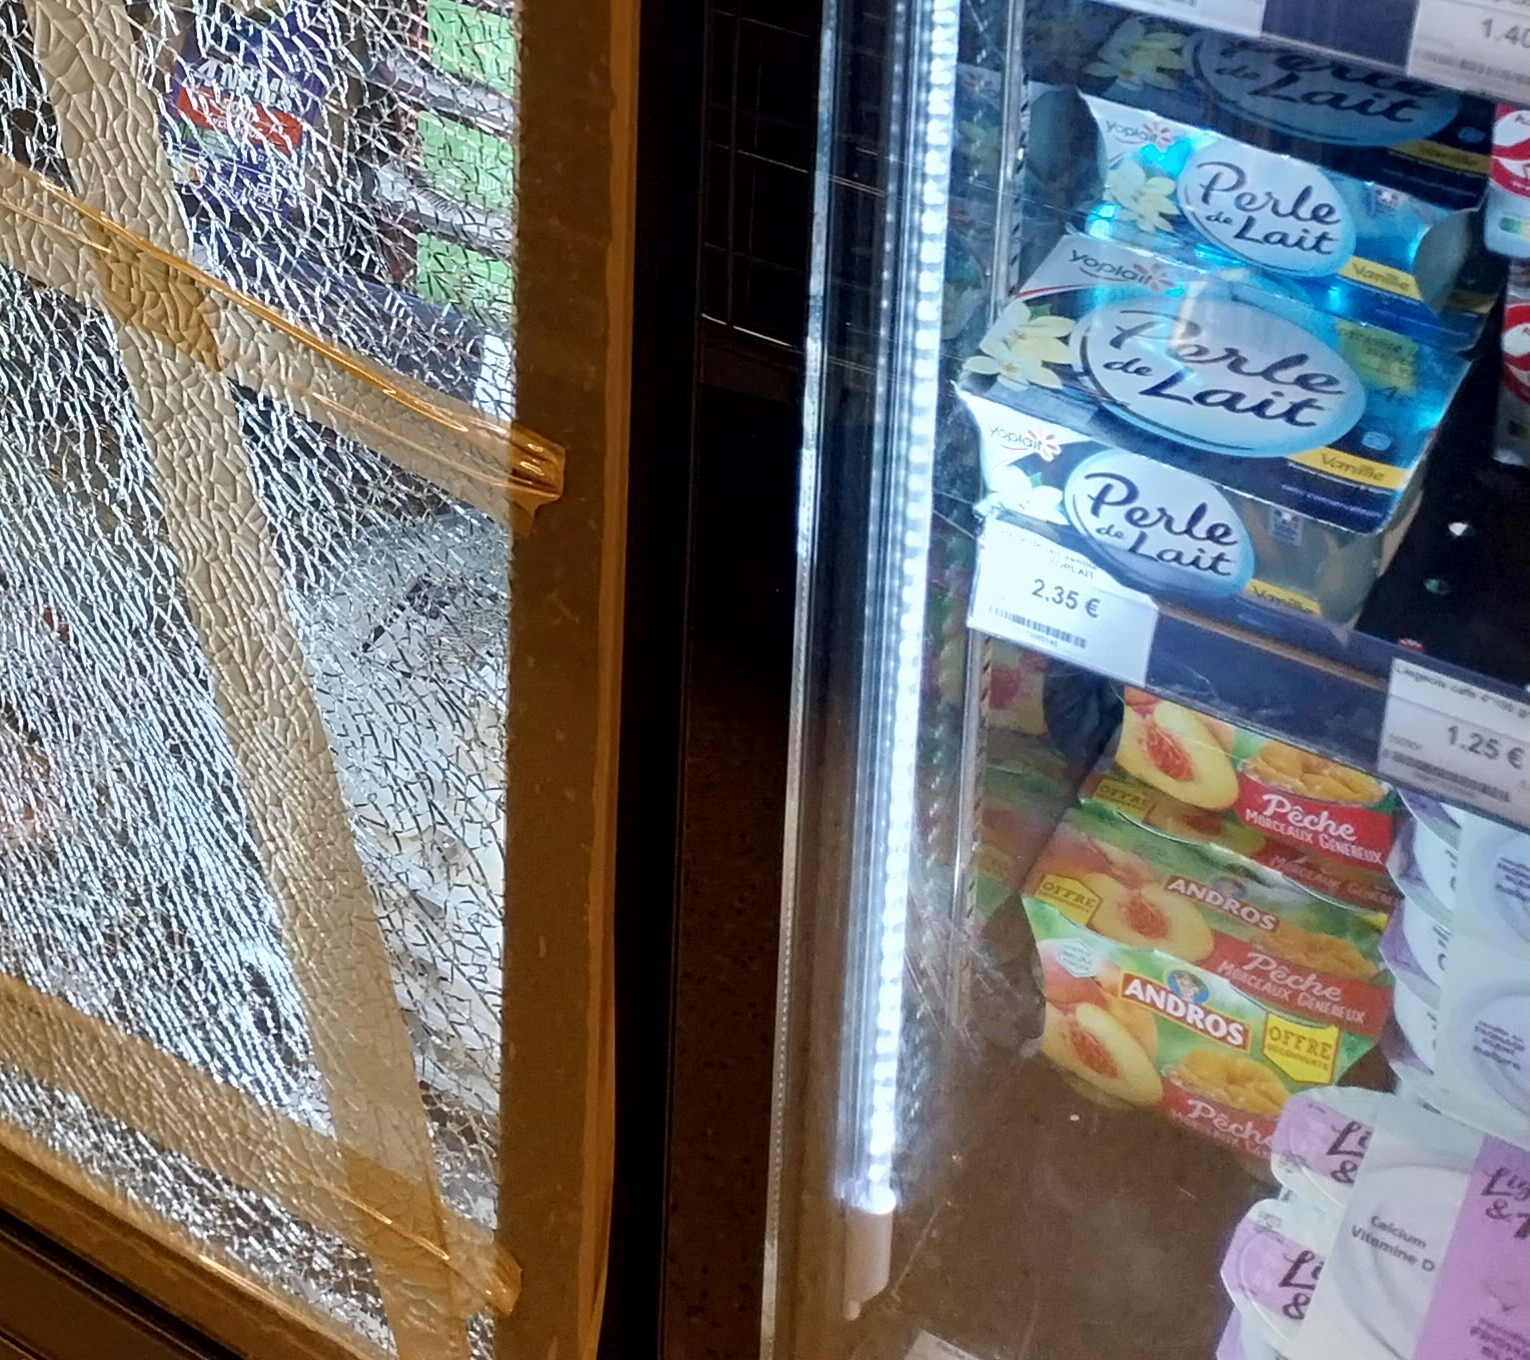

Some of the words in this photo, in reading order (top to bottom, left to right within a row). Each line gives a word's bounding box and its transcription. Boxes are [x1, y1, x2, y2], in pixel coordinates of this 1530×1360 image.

[1248, 70, 1423, 124] Lait
[1104, 119, 1158, 144] yoplait
[1196, 160, 1343, 226] Perle
[1205, 211, 1233, 226] de
[1234, 214, 1339, 256] Lait
[1070, 249, 1152, 286] yoplait
[1351, 260, 1411, 293] Vanille
[1108, 308, 1346, 396] Perle
[1102, 356, 1155, 378] de
[1137, 372, 1328, 429] Lait
[988, 425, 1046, 450] yoplait
[1319, 452, 1387, 483] Vanille
[1084, 470, 1241, 547] Perle
[1095, 521, 1125, 540] de
[1128, 531, 1236, 579] Lait
[1031, 578, 1080, 611] 2.35
[1084, 597, 1102, 619] €
[1447, 725, 1501, 761] 1.25
[1507, 746, 1526, 770] €
[1261, 792, 1359, 843] Pêche
[1041, 880, 1097, 910] OFFRE
[1166, 877, 1280, 932] ANDROS
[1242, 949, 1343, 1003] Pêche
[1123, 978, 1246, 1049] ANDROS
[1269, 1025, 1333, 1060] OFFRE
[1330, 1159, 1360, 1185] &
[1350, 1225, 1419, 1266] Vitamine
[1421, 1258, 1436, 1273] D
[1370, 1215, 1427, 1250] Calcium
[1282, 1291, 1312, 1321] &
